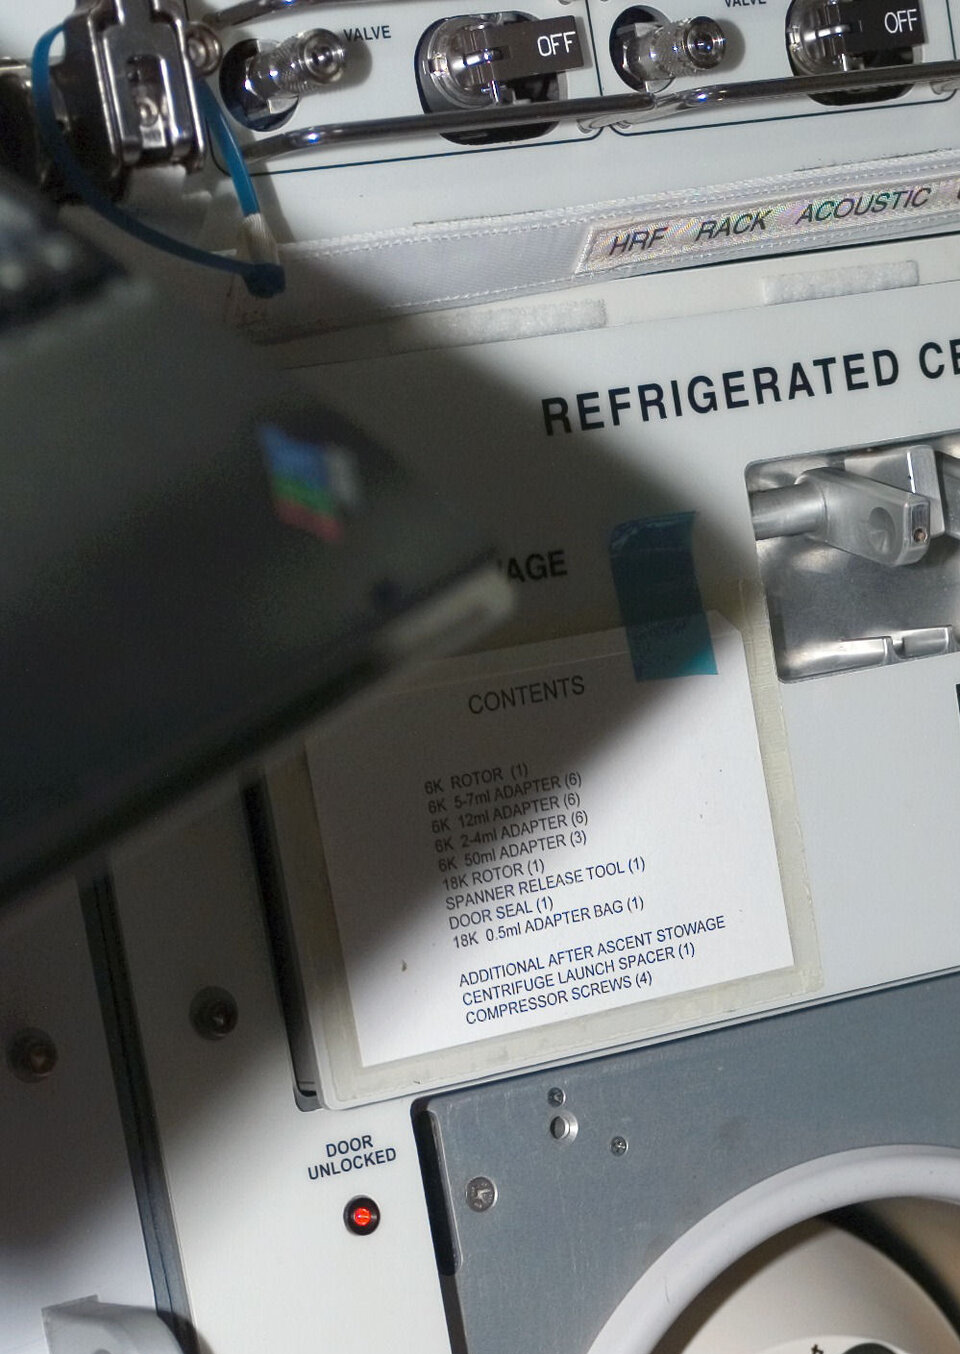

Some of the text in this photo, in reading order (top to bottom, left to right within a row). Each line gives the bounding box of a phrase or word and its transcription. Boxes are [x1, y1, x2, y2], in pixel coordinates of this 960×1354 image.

[344, 25, 391, 41] VALVE
[885, 8, 918, 34] OFF
[537, 31, 576, 57] OFF
[609, 226, 671, 257] HRF
[695, 208, 773, 242] RACK
[794, 186, 932, 225] ACOUSTIC
[542, 348, 900, 437] REFRIGERATED
[468, 674, 585, 715] CONTENTS
[424, 763, 529, 794] 6K ROTOR (1)
[428, 771, 582, 814] 6K 5-7ml ADAPTER (6)
[431, 792, 581, 834] 6K 12ml ADAPTER (6)
[435, 810, 588, 853] 6K 2-4ml ADAPTER (6)
[438, 829, 587, 872] 6K 50ml ADAPTER (3)
[443, 858, 545, 892] 18K ROTOR (1)
[445, 856, 646, 911] SPANNER RELEASE TOOL (1)
[449, 895, 554, 930] DOOR SEAL (1)
[453, 895, 644, 949] 18K 0.5ml ADAPTER BAG (1)
[459, 915, 726, 988] ADDITIONAL AFTER ASCENT STOWAGE
[462, 942, 695, 1006] CENTRIFUGE LAUNCH SPACER (1)
[465, 970, 653, 1025] COMPRESSOR SCREWS (4)
[308, 1148, 397, 1180] UNLOCKED
[326, 1135, 373, 1157] DOOR
